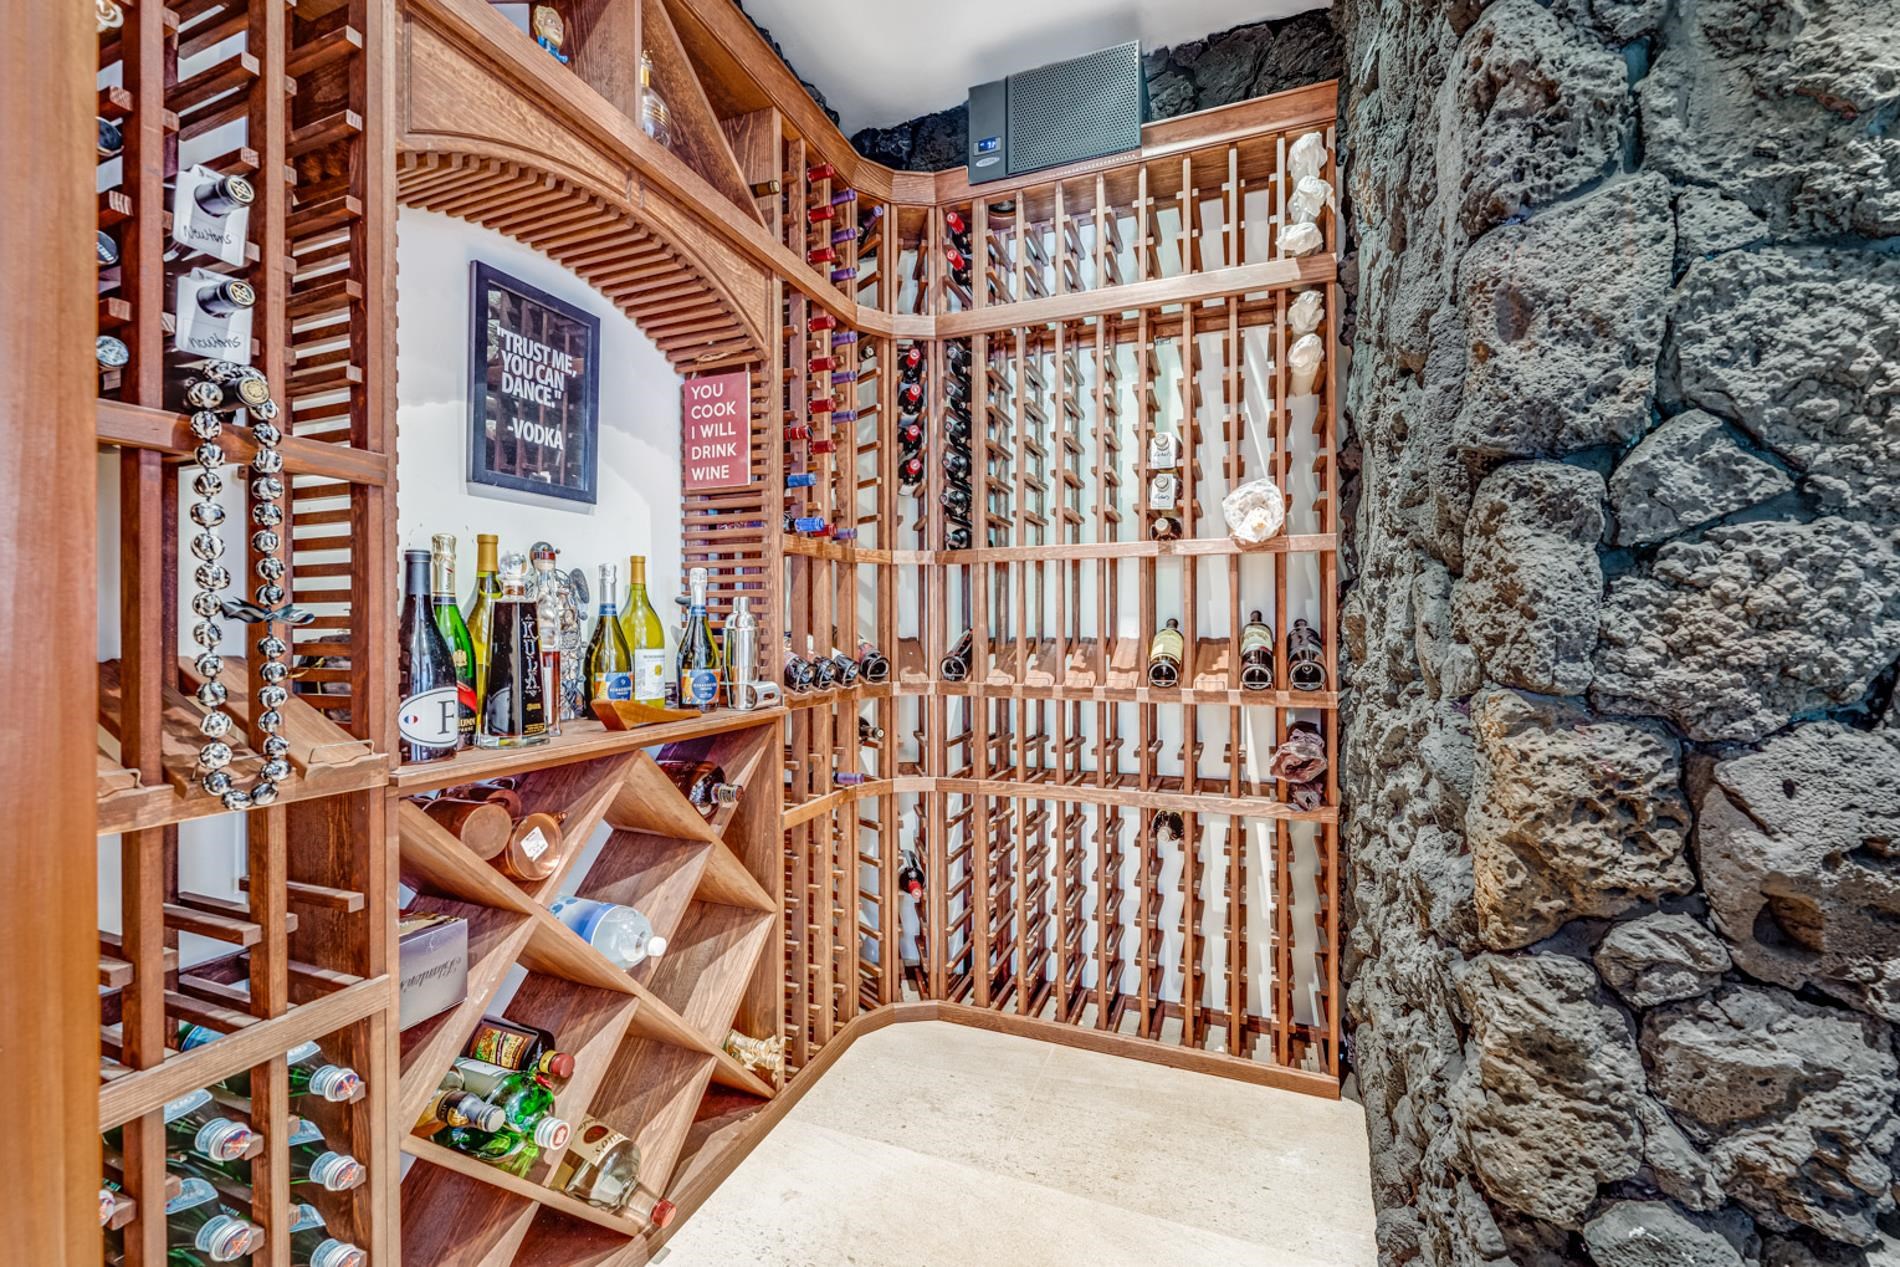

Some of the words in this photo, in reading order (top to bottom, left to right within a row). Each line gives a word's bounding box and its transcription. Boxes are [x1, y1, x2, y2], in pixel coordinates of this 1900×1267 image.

[501, 350, 534, 380] YOU
[535, 364, 565, 392] CAN
[551, 348, 578, 379] ME,
[691, 383, 723, 400] YOU
[691, 400, 736, 420] COOK
[691, 425, 696, 440] I
[700, 422, 736, 438] WILL
[691, 442, 737, 460] DRINK
[691, 465, 729, 481] WINE
